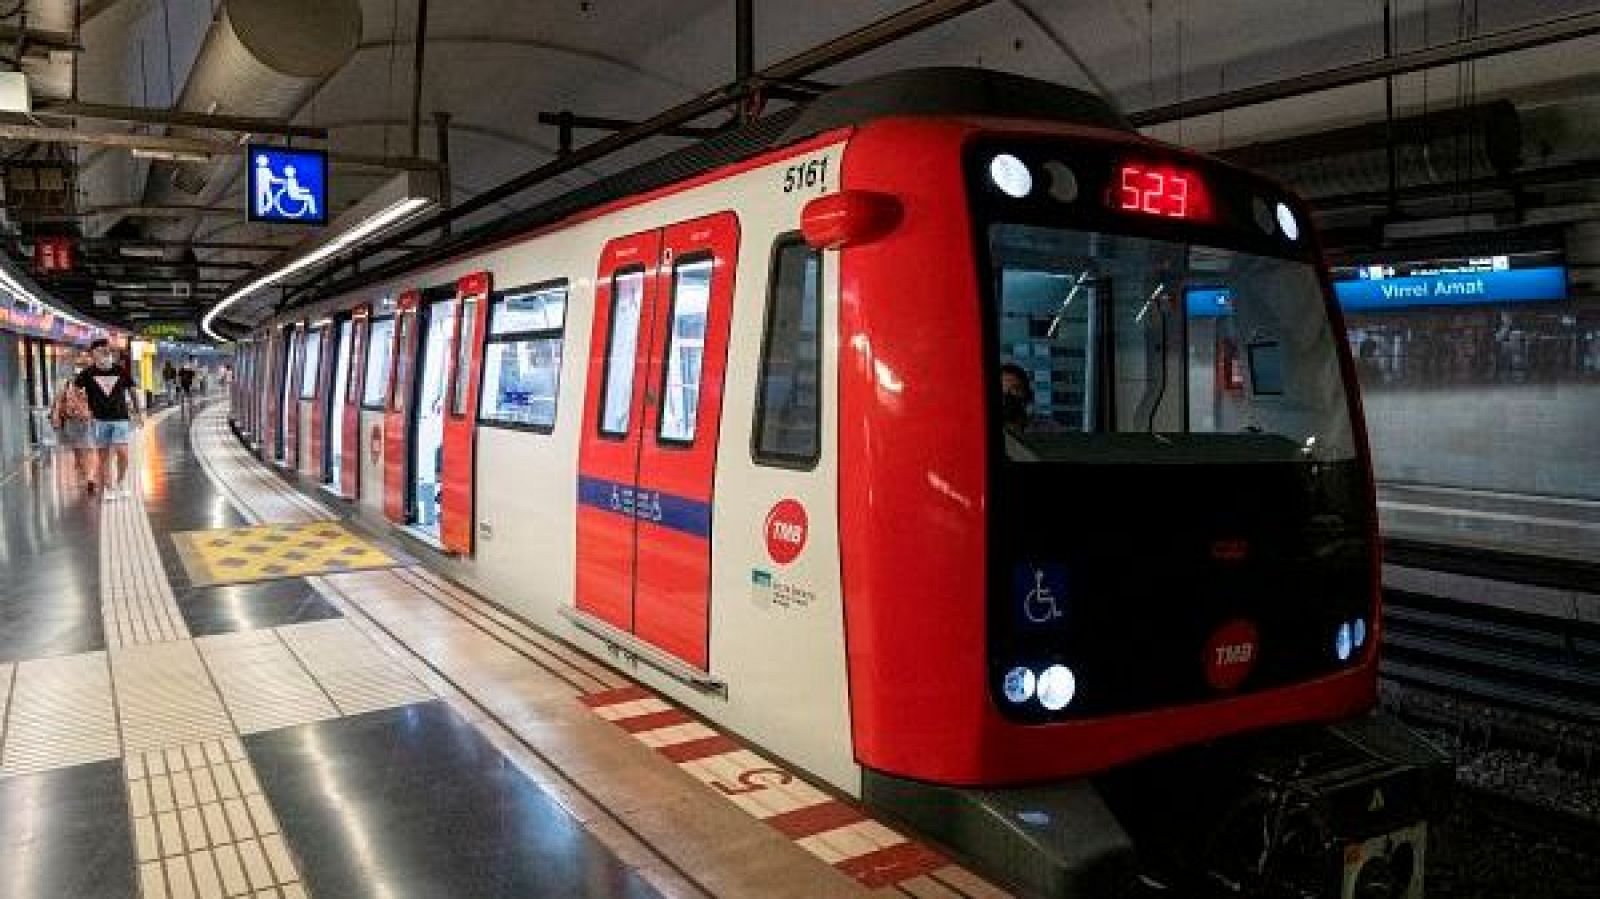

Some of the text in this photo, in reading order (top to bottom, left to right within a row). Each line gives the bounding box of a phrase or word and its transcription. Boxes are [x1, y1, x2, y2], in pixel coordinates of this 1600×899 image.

[1121, 166, 1188, 218] 523
[1434, 279, 1484, 297] Amat
[772, 522, 804, 544] TMB
[1215, 642, 1255, 667] TMB
